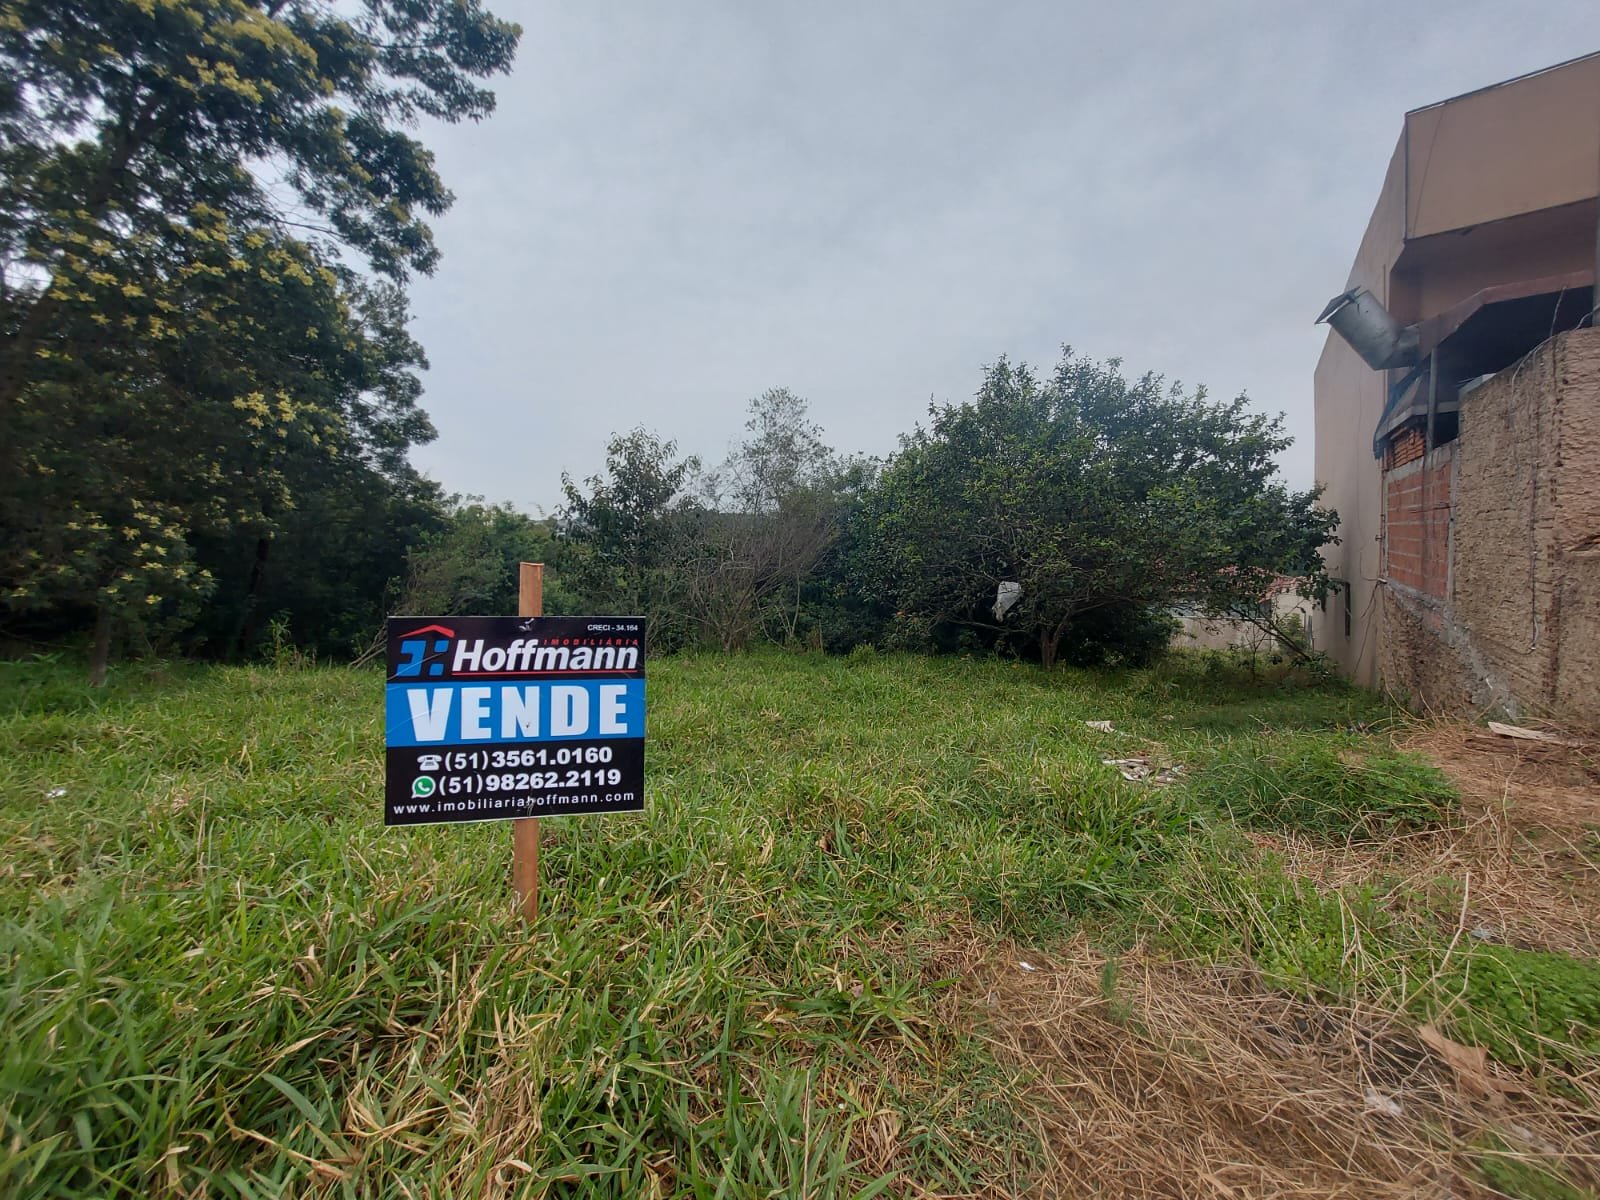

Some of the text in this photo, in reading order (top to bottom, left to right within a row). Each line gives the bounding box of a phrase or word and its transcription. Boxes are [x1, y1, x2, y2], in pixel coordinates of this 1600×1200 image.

[587, 624, 610, 632] CRECI
[451, 639, 638, 671] Hoffmann
[407, 684, 628, 741] VENDE
[393, 791, 635, 815] www.imobiliariahoffmann.com
